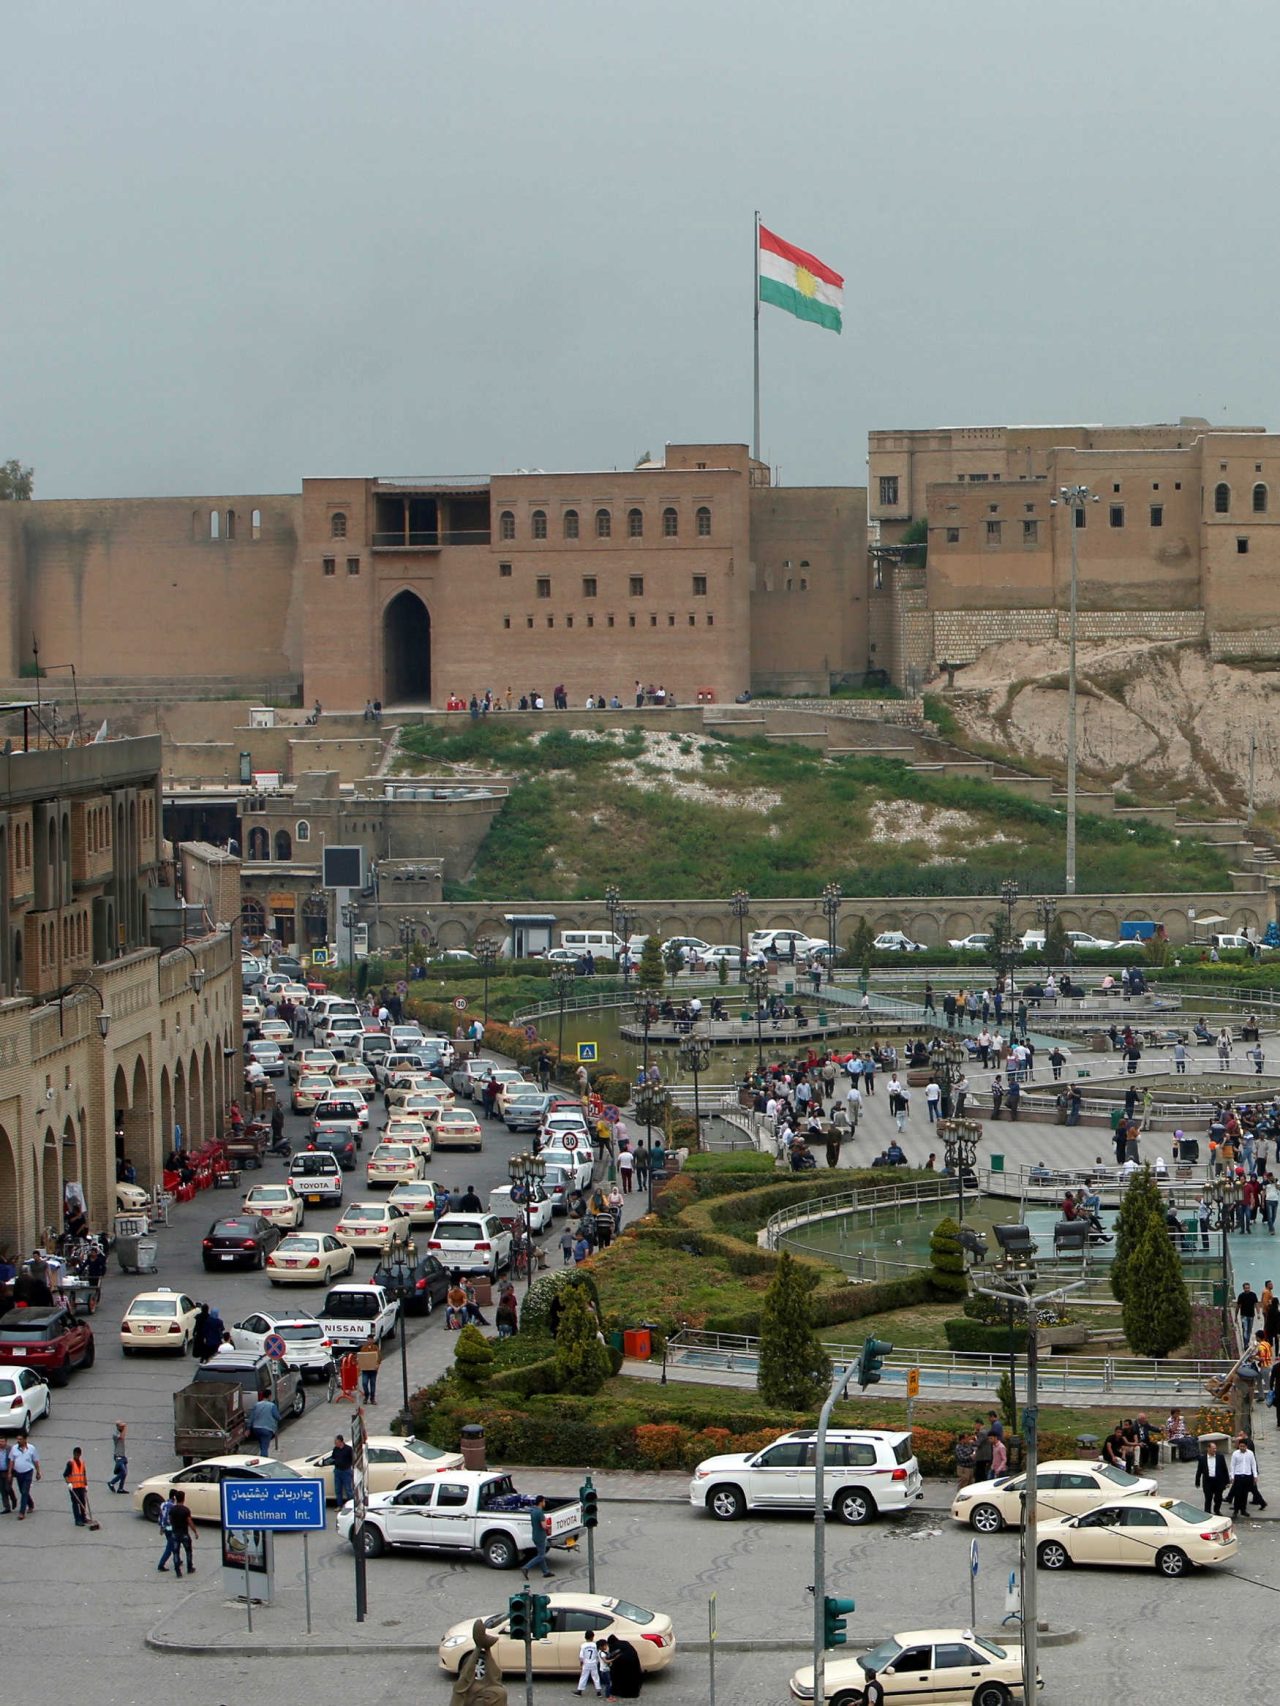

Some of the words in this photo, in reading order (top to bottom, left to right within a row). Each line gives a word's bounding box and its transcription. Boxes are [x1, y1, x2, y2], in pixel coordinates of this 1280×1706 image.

[566, 1137, 575, 1146] 30
[299, 1182, 329, 1190] TOYOTA
[324, 1324, 364, 1333] NISSAN
[237, 1510, 287, 1520] Nishtiman
[294, 1510, 310, 1520] Int.
[556, 1515, 577, 1530] TOYOTA
[588, 1649, 593, 1660] 7
